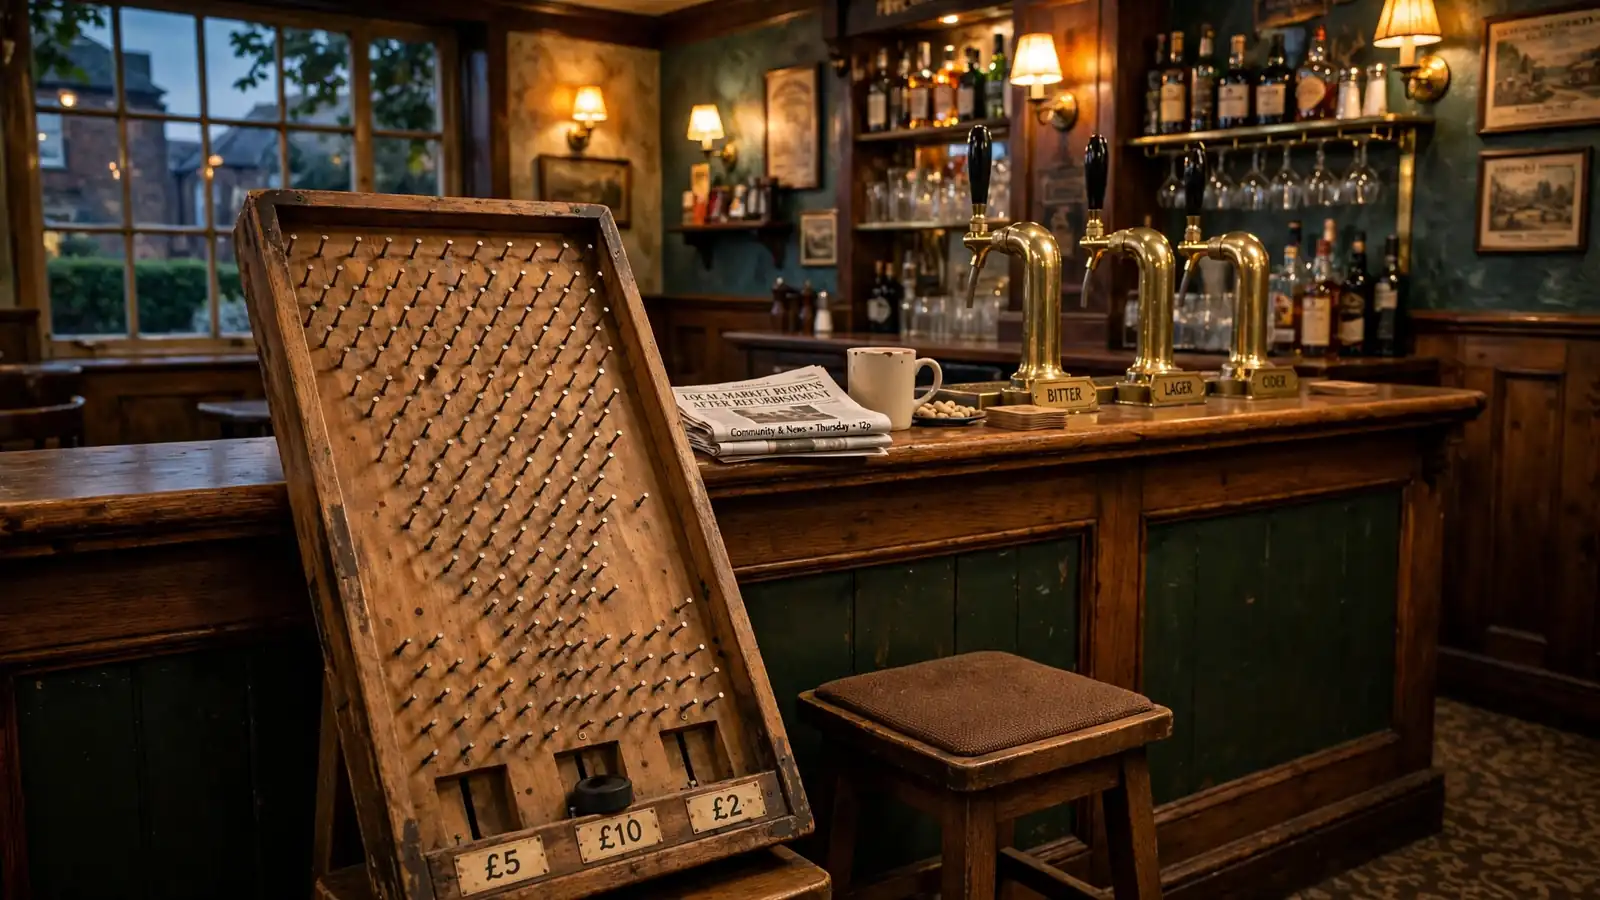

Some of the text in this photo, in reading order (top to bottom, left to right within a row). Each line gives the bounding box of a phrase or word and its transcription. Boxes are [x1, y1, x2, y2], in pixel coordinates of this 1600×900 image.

[682, 393, 721, 401] LOCAL
[722, 388, 770, 400] MARKET
[772, 380, 825, 395] REOPENS
[1047, 387, 1083, 402] BITTER
[1164, 380, 1193, 396] LAGER
[693, 389, 831, 408] AFTER REFURBISHMENT
[730, 421, 872, 437] Community & News Thursday 12p
[712, 794, 743, 821] £2
[598, 818, 643, 851] £10
[484, 848, 521, 881] £5
